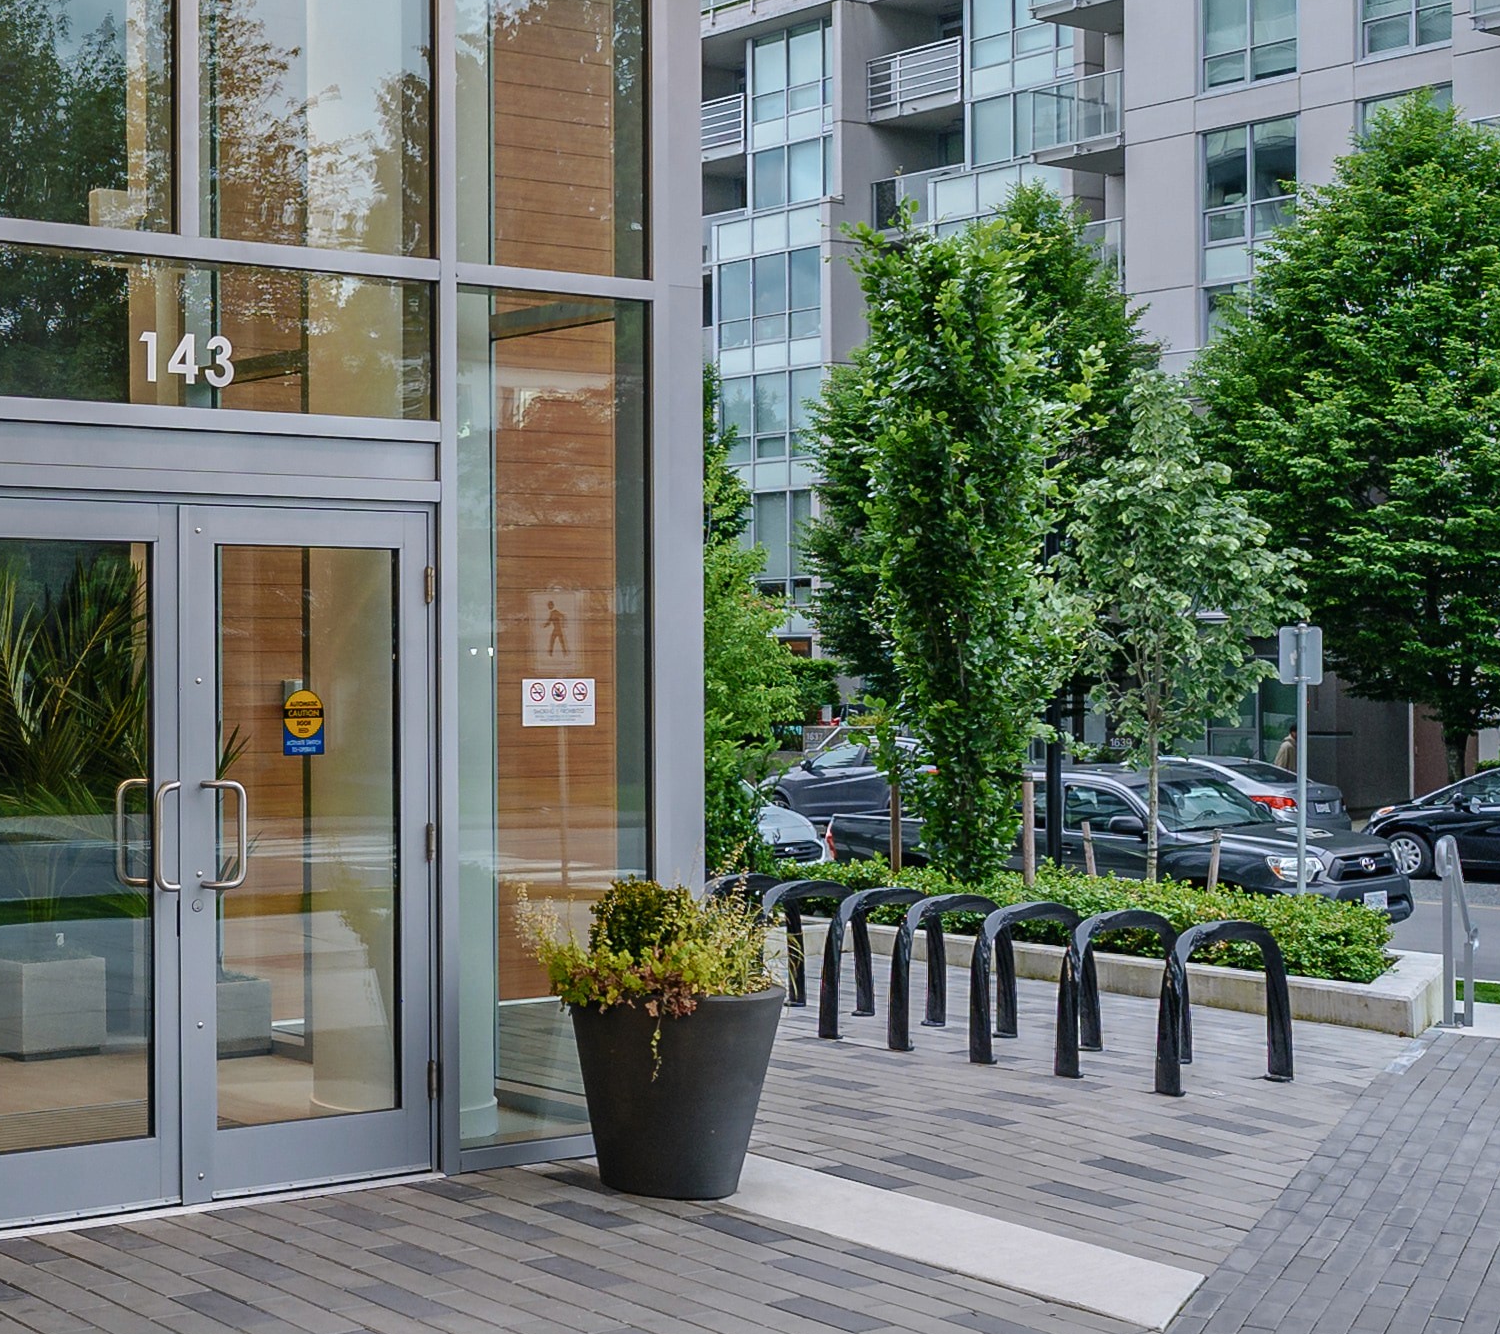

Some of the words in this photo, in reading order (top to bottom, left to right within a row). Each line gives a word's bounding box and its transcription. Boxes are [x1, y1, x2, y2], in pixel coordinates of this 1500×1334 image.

[139, 331, 236, 388] 143
[288, 709, 319, 717] CAUTION
[1110, 737, 1133, 747] 1639
